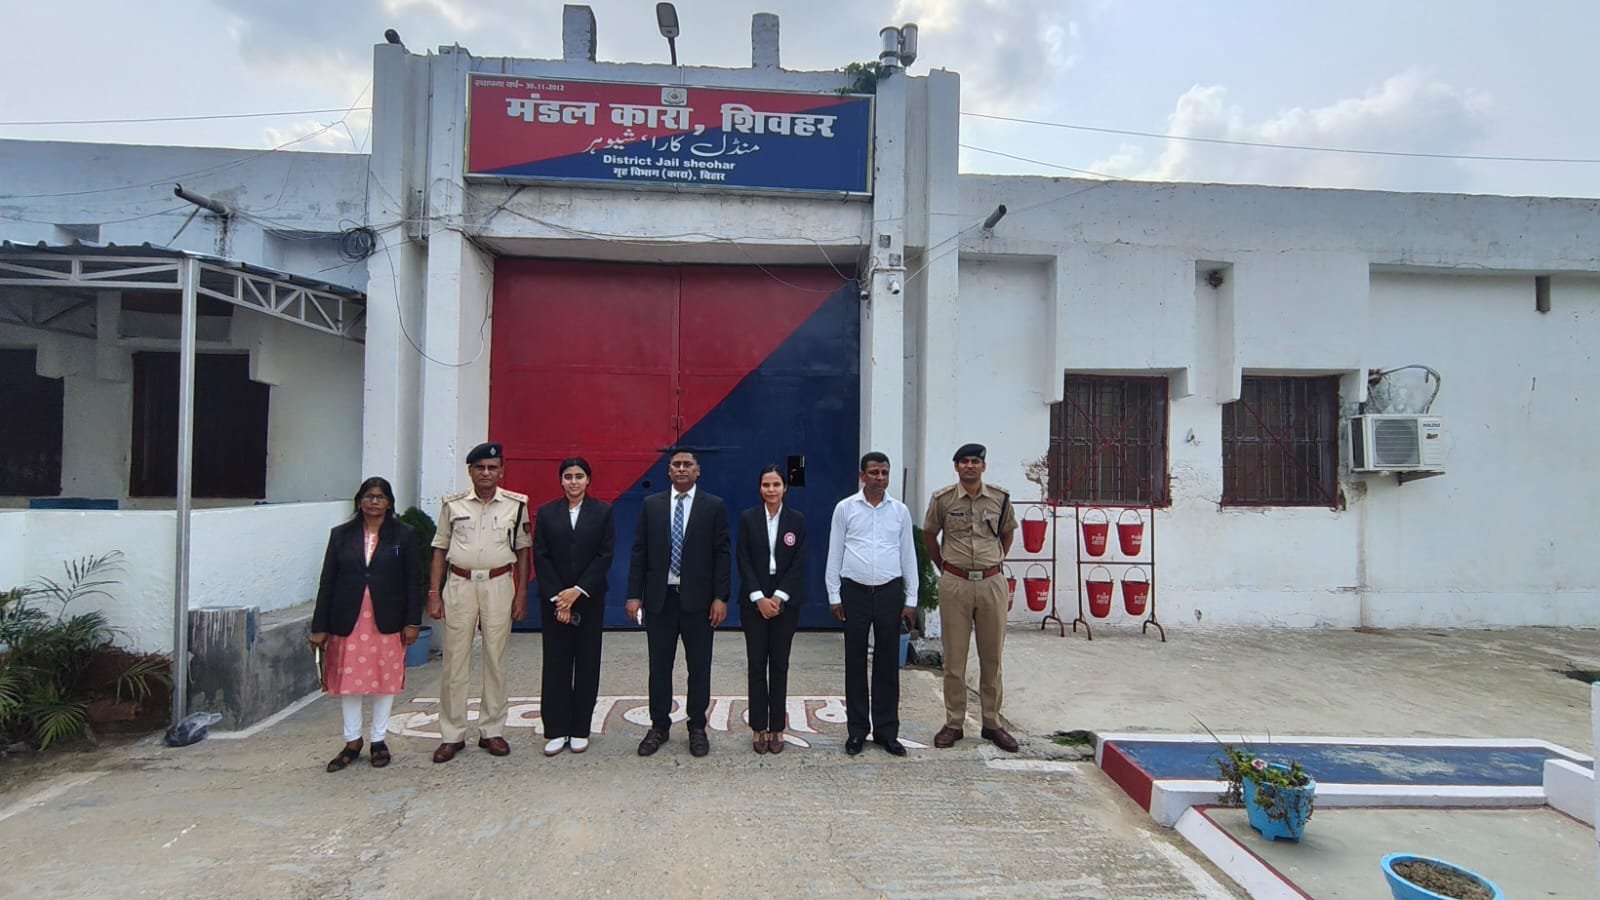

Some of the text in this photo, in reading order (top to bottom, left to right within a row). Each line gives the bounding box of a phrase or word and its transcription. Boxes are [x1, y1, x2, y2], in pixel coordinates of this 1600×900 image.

[505, 93, 600, 126] मंडल
[720, 103, 838, 138] शिवहर
[603, 154, 737, 170] District Jail sheohar
[630, 166, 660, 178] विभाग
